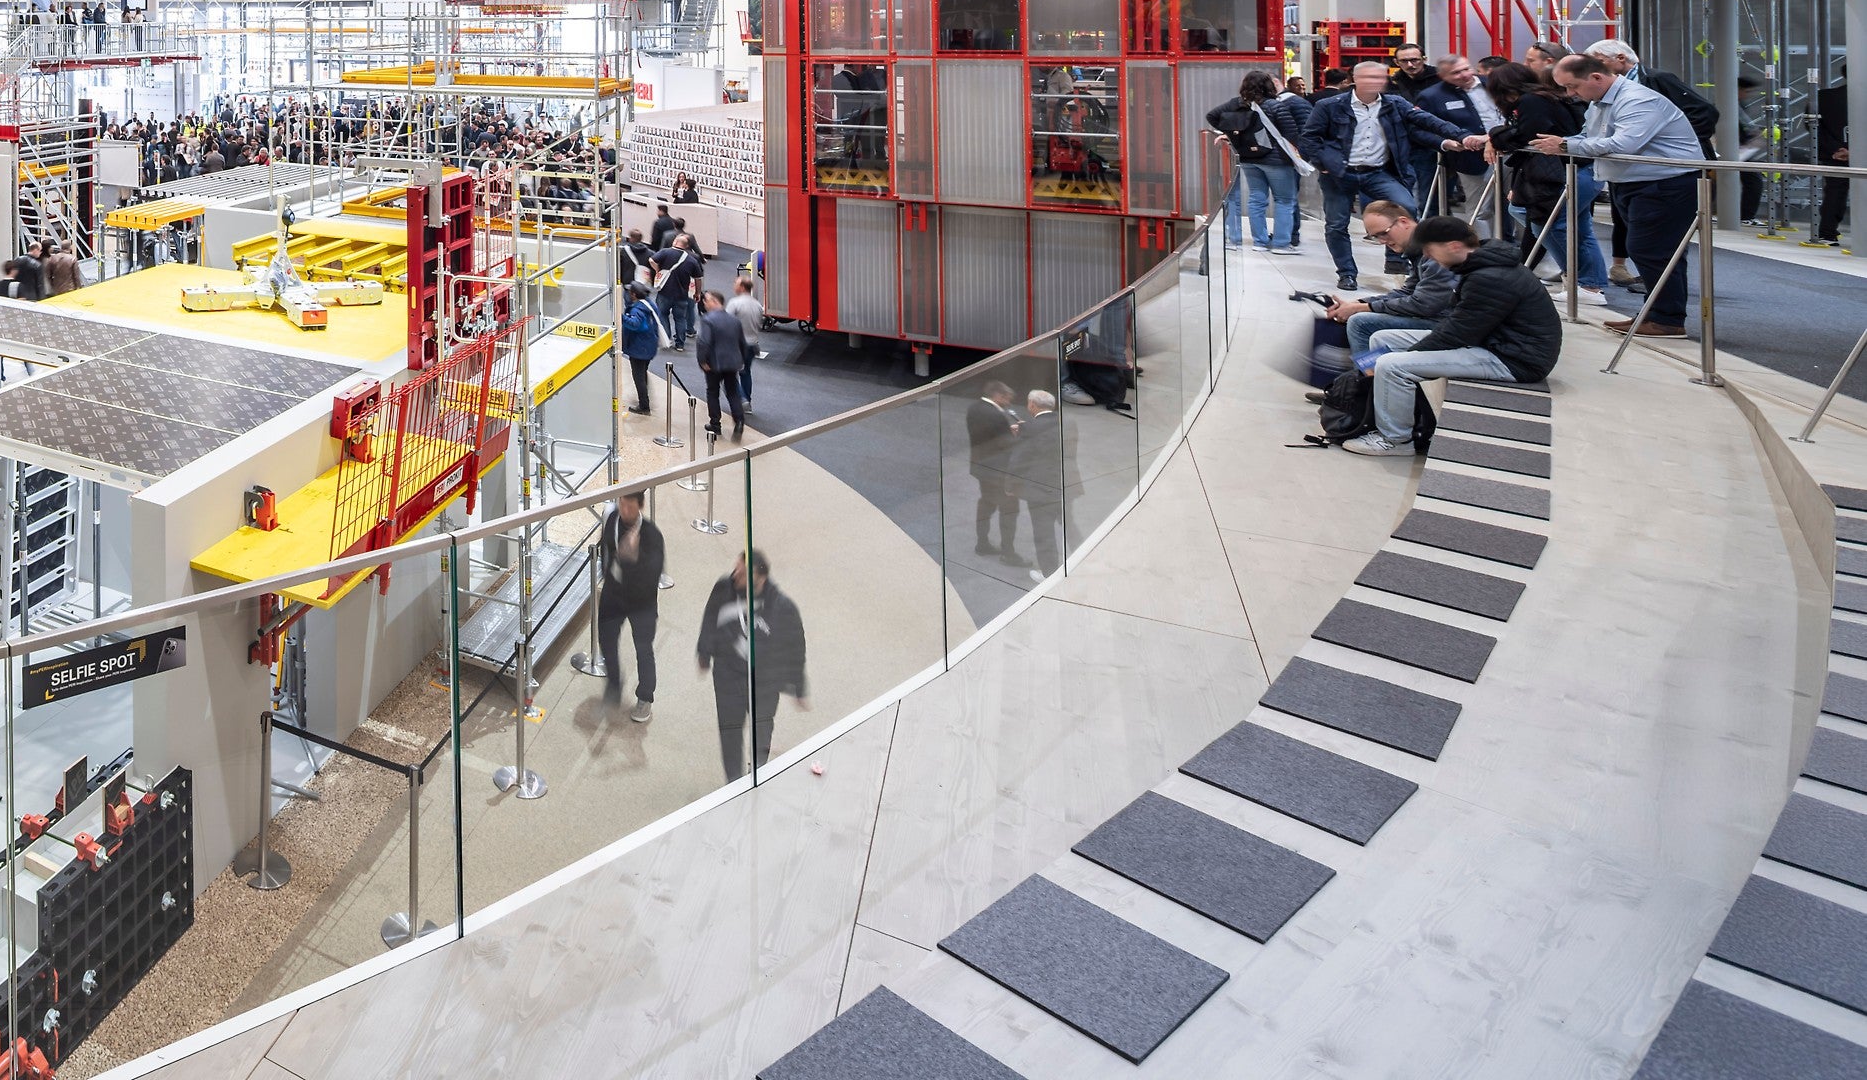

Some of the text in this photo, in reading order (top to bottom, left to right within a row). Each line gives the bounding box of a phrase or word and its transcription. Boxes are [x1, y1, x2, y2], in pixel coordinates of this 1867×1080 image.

[578, 325, 595, 336] PERI
[446, 468, 463, 486] PROKIT
[51, 653, 136, 687] SELFIE SPOT
